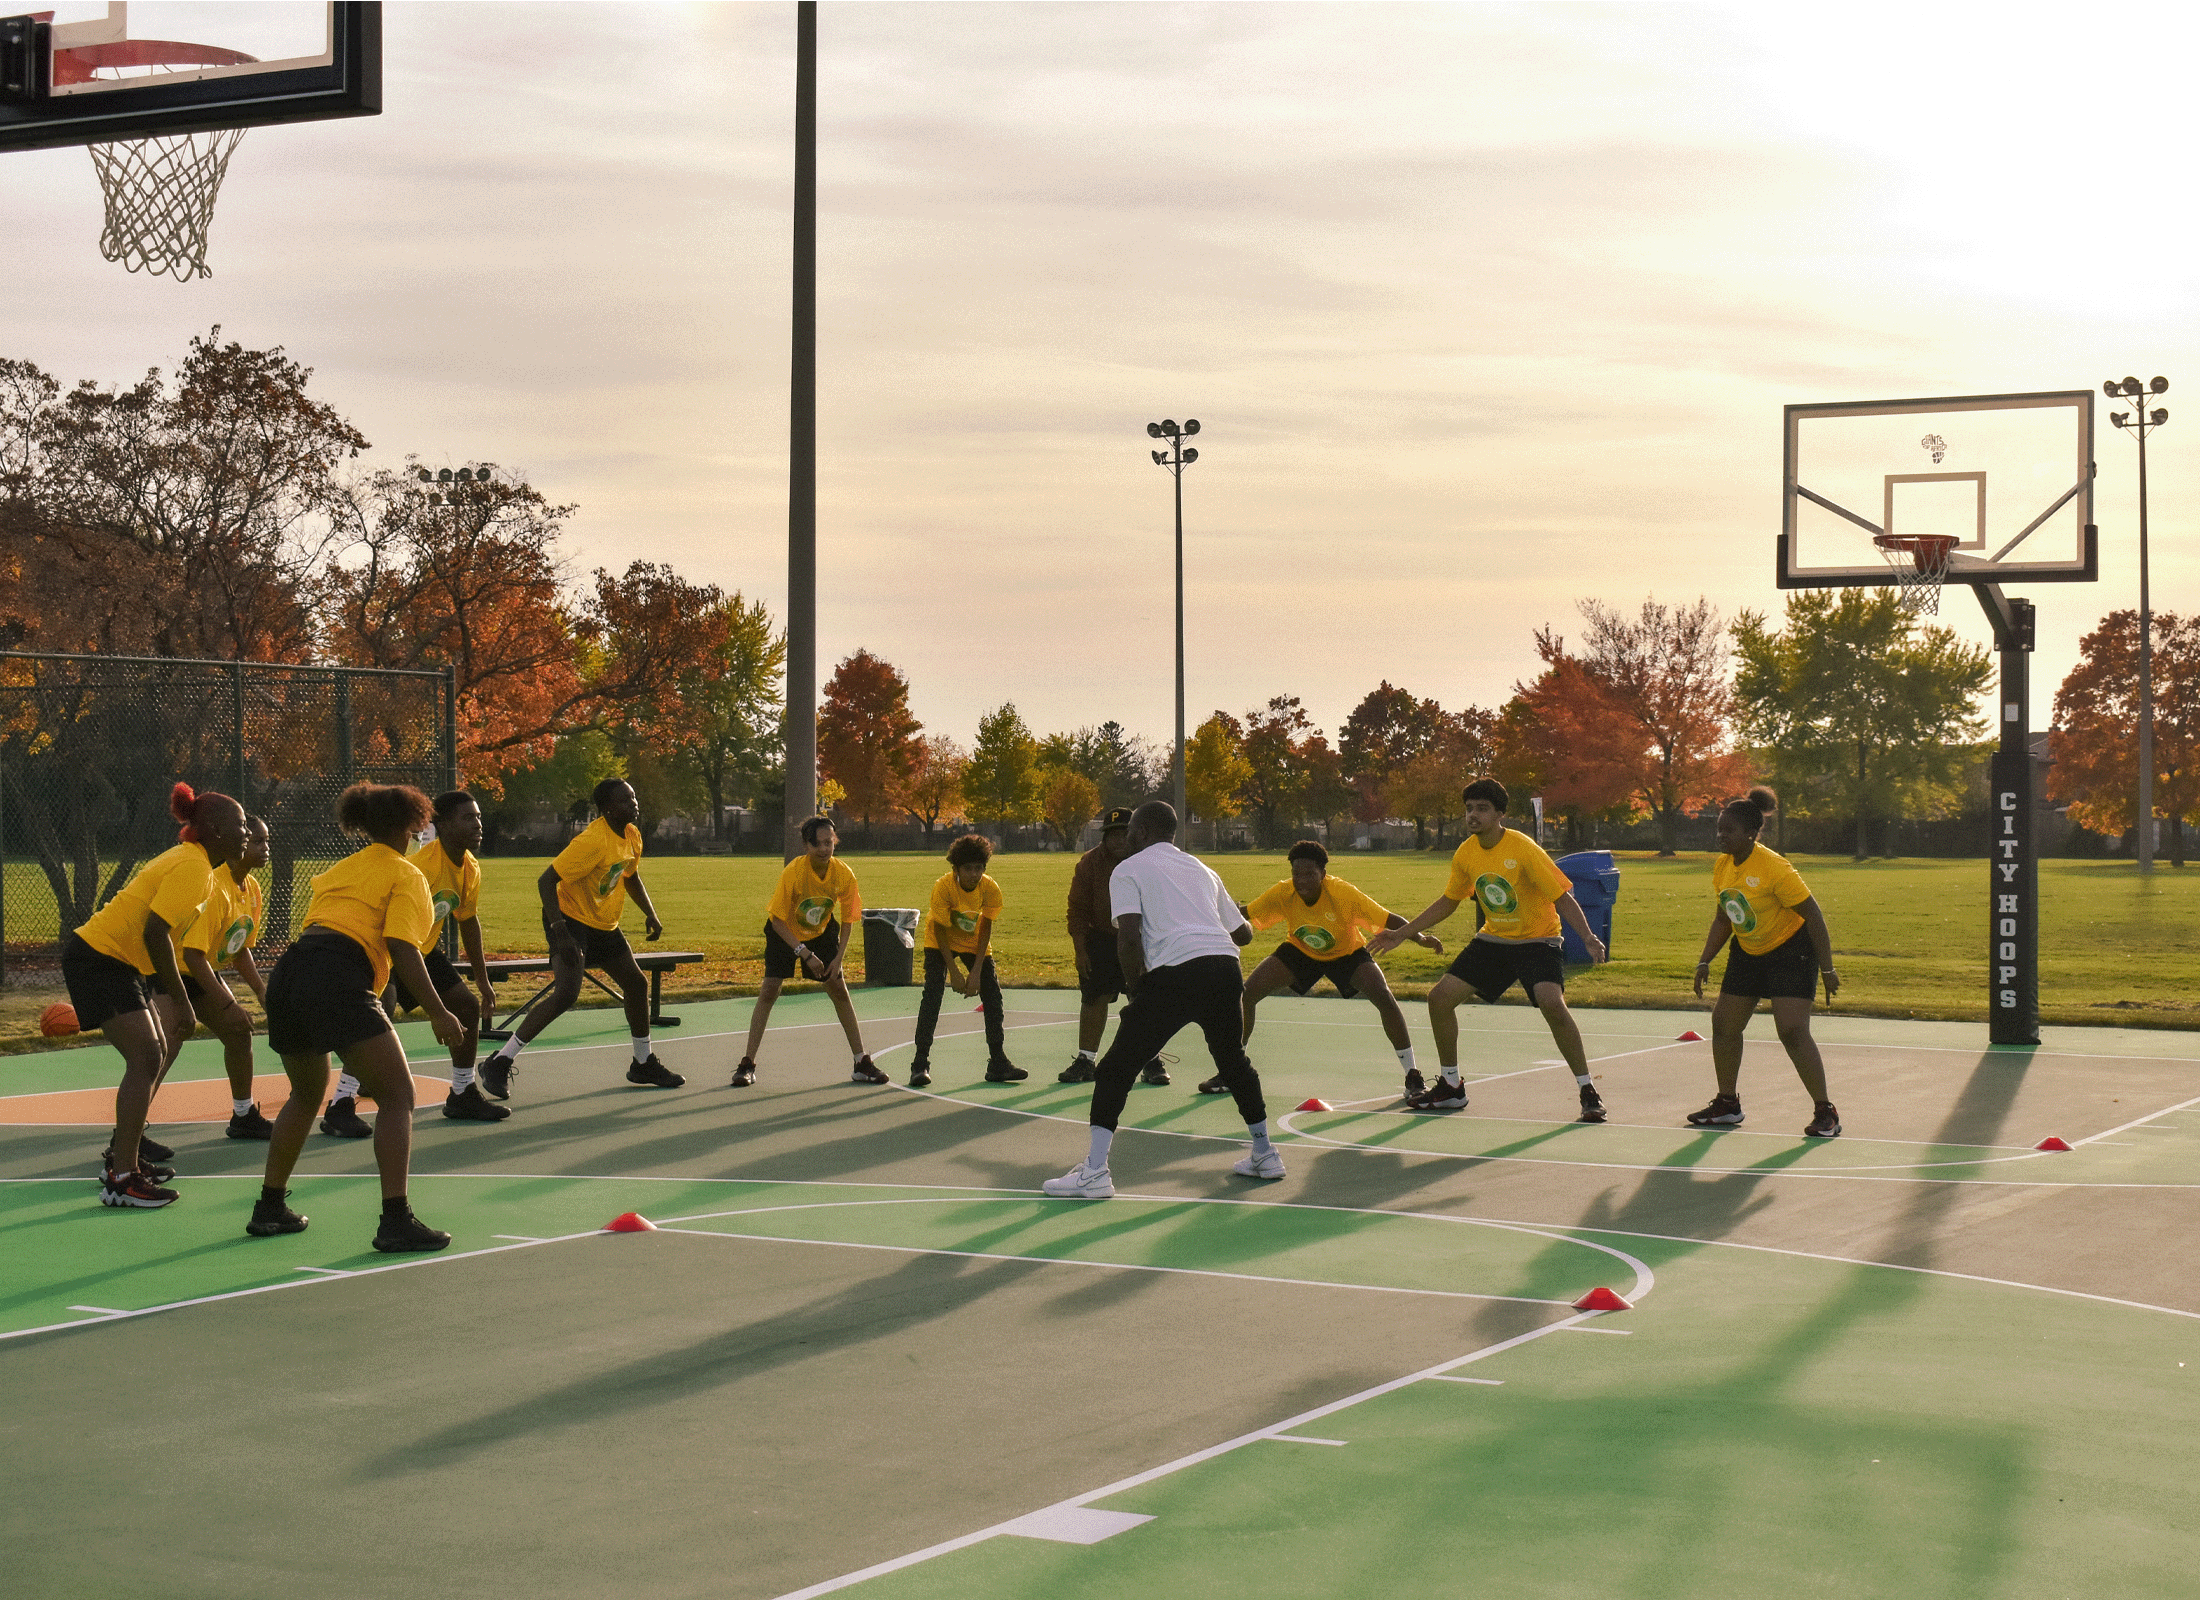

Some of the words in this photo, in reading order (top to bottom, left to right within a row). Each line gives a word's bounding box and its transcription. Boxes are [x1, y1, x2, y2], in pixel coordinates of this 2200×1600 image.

[1111, 811, 1119, 822] P
[1999, 792, 2018, 882] CITY
[1999, 894, 2018, 1008] HOOPS
